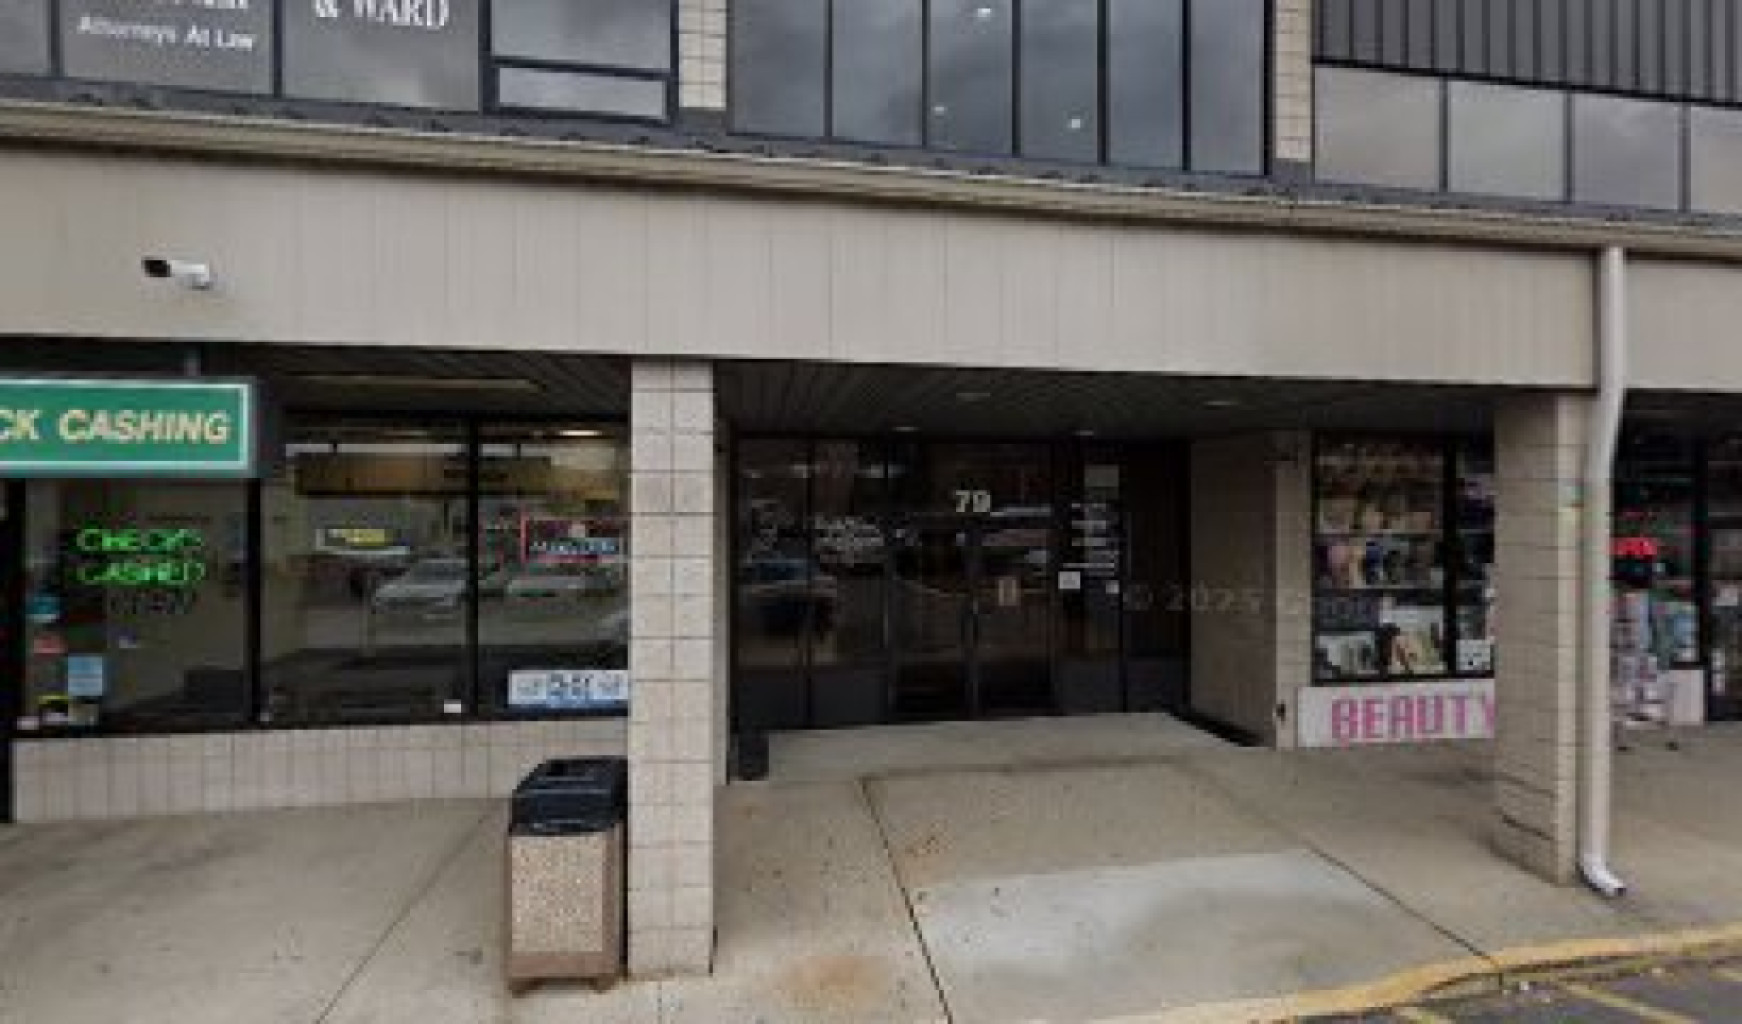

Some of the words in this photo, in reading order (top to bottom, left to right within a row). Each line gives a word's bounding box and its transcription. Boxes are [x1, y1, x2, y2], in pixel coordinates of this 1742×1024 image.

[353, 0, 449, 29] WARD
[185, 24, 210, 48] At
[215, 29, 256, 52] Law
[58, 409, 231, 444] CASHING
[76, 561, 207, 586] CASHED
